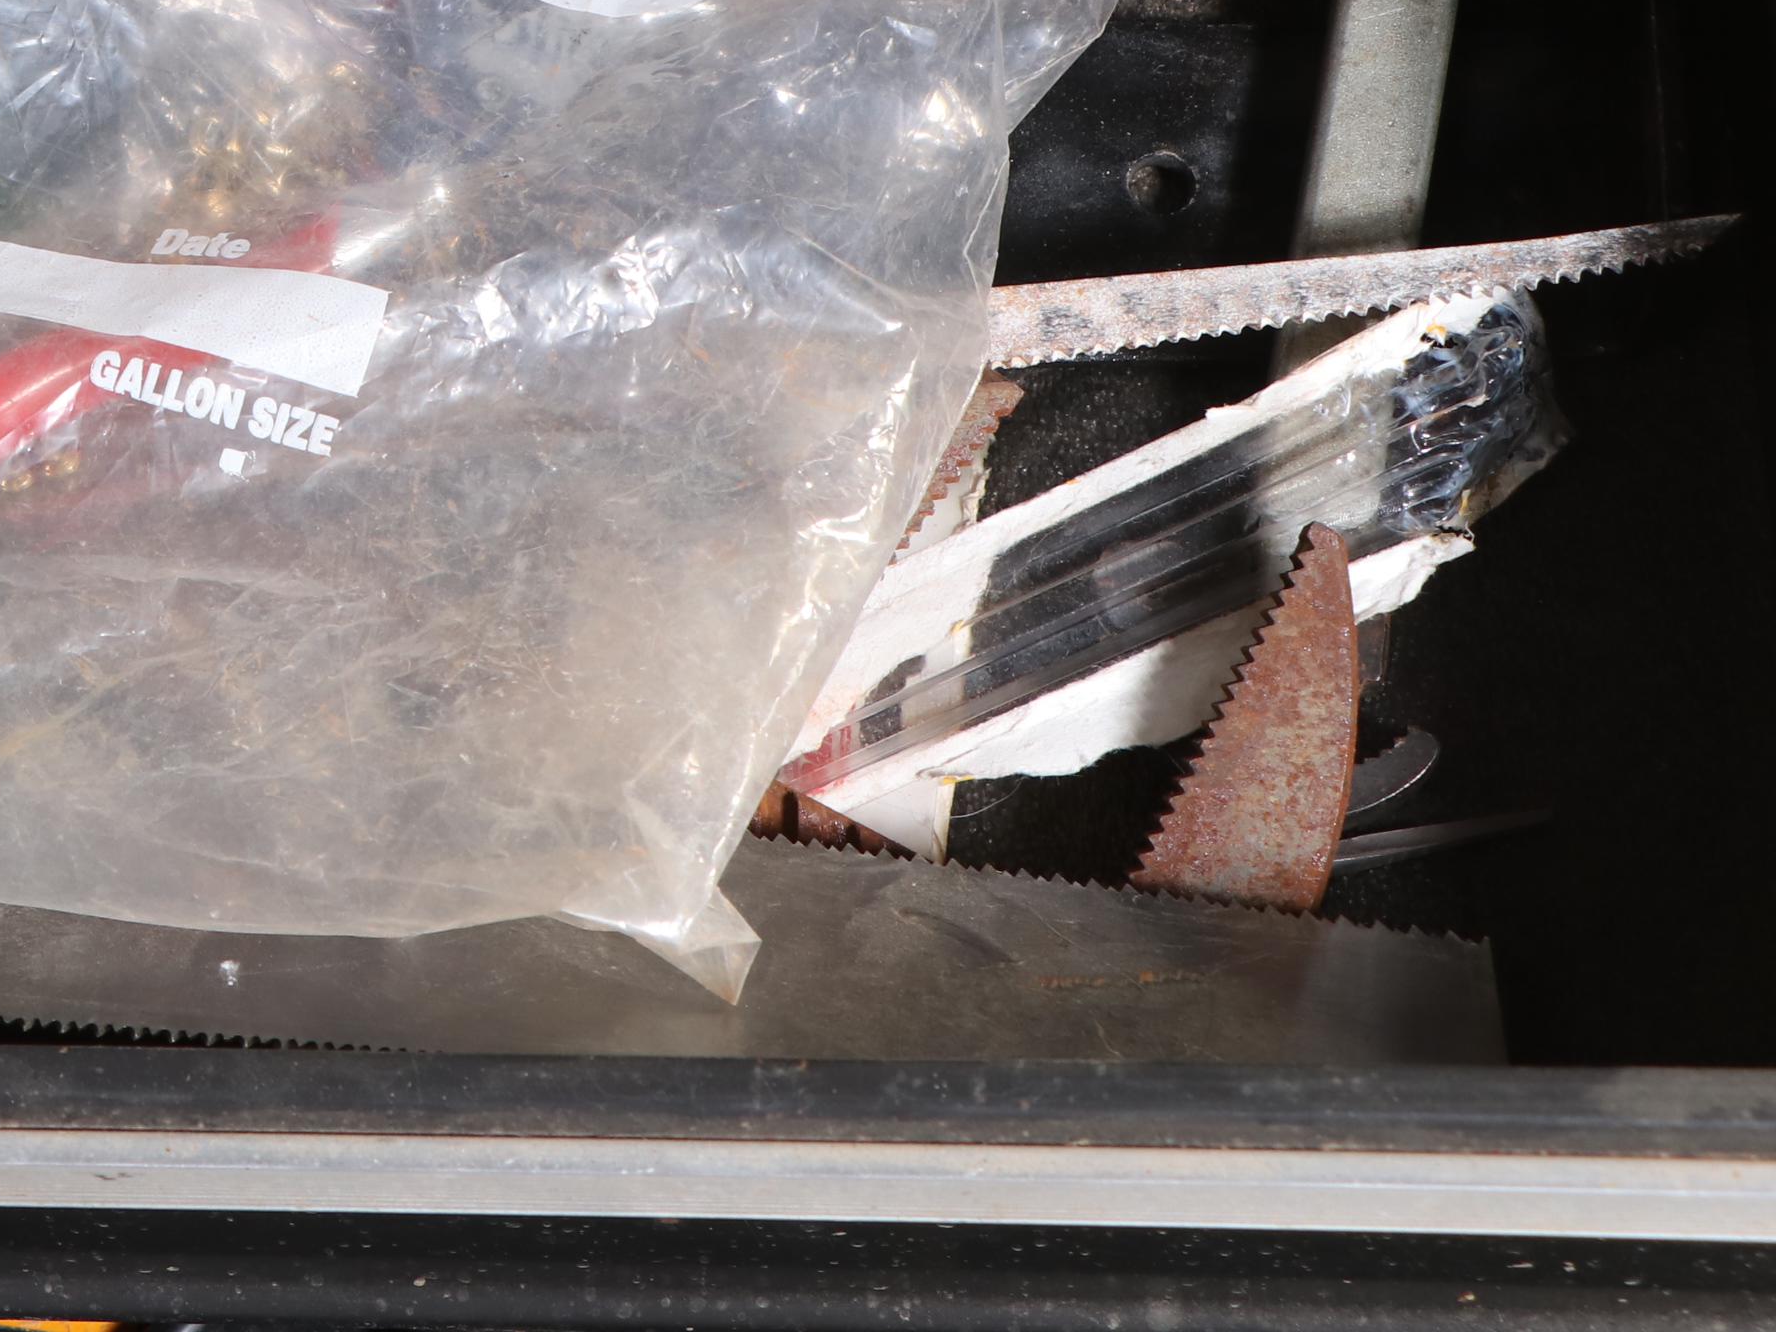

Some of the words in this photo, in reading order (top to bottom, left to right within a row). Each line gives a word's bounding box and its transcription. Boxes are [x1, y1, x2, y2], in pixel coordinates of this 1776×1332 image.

[151, 228, 251, 260] Date
[88, 349, 243, 429] GALLON
[251, 394, 343, 457] SIZE
